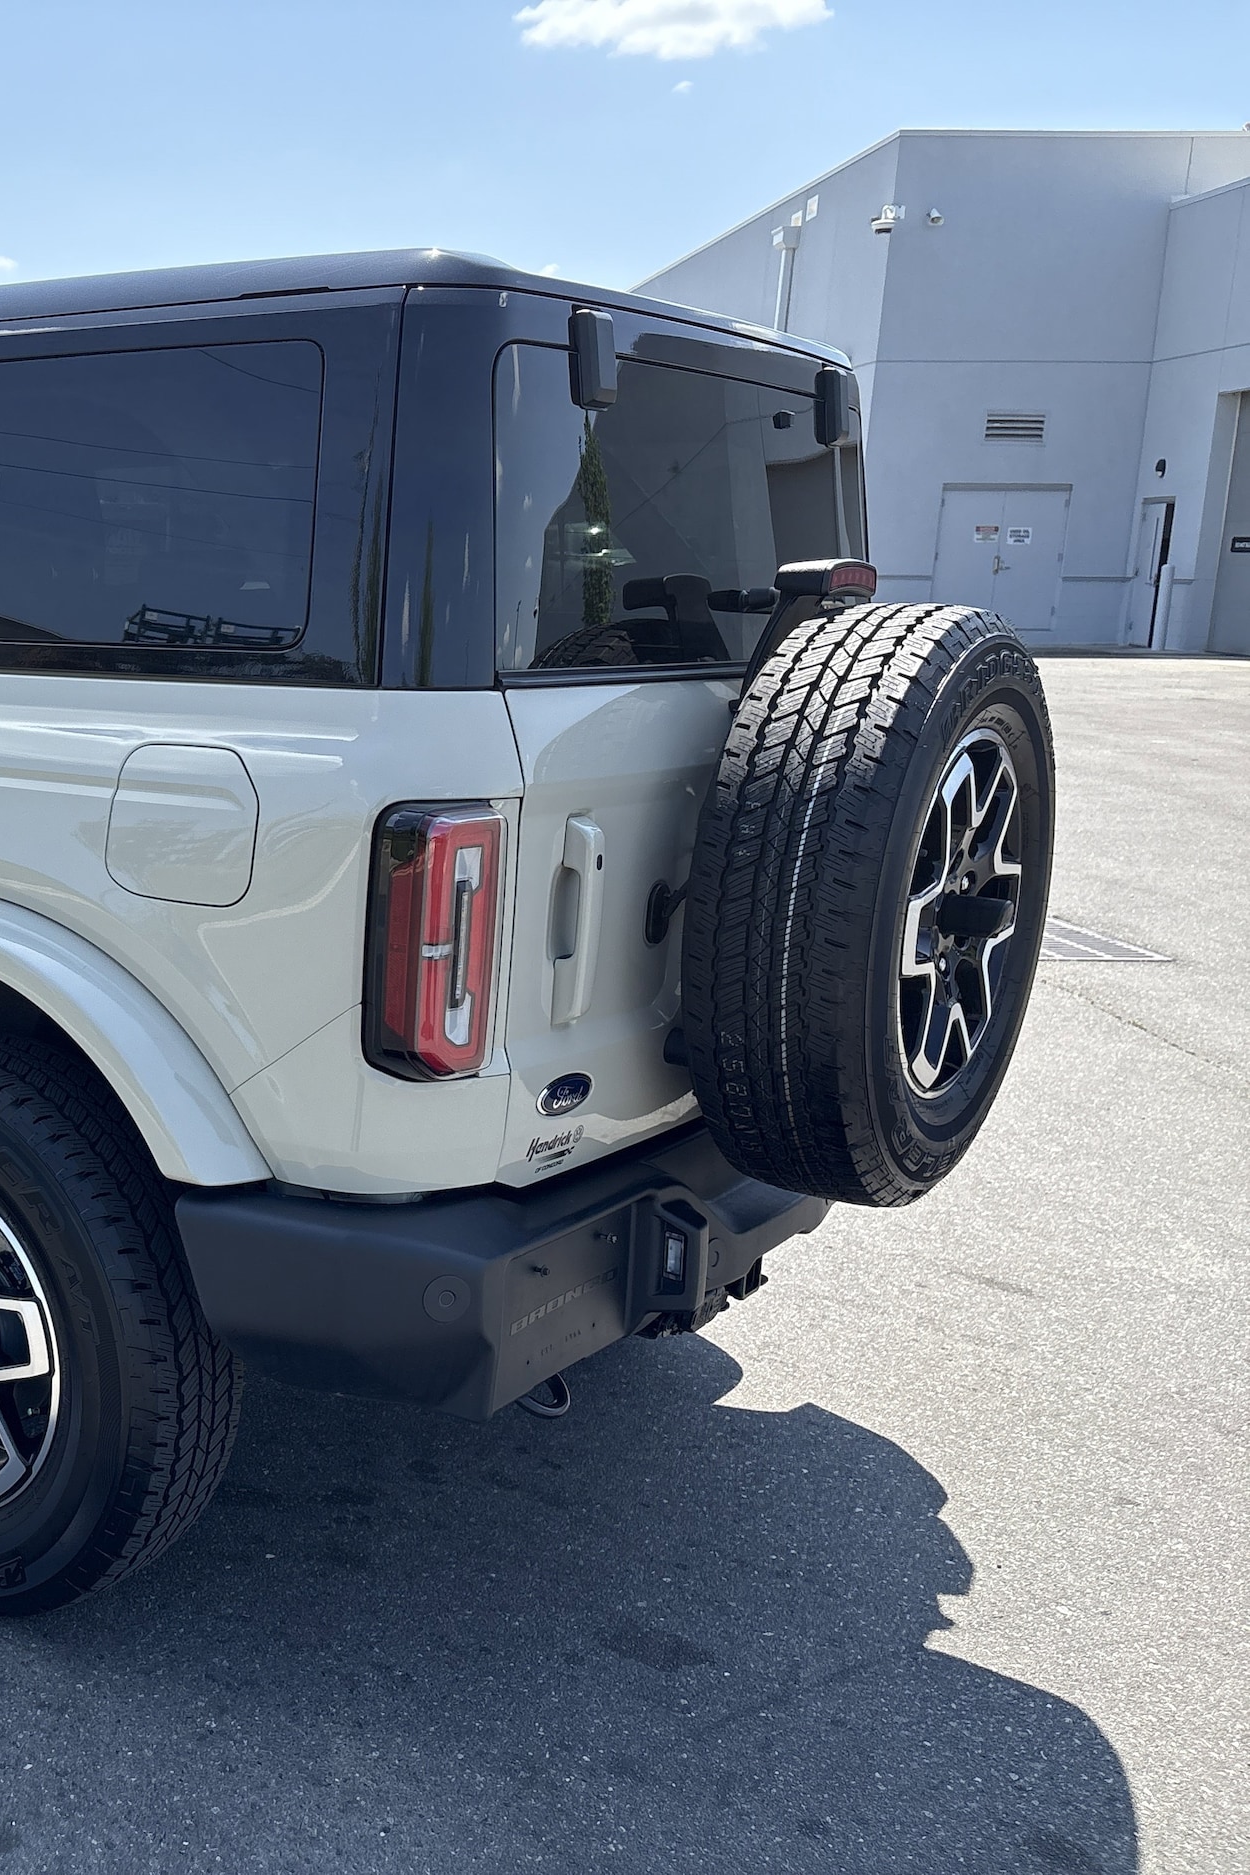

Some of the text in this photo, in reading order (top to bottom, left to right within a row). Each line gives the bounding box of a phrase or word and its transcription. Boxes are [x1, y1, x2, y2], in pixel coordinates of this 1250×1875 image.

[552, 1085, 584, 1109] Ford
[525, 1130, 573, 1162] Hendrick
[509, 1267, 617, 1336] BRONCO
